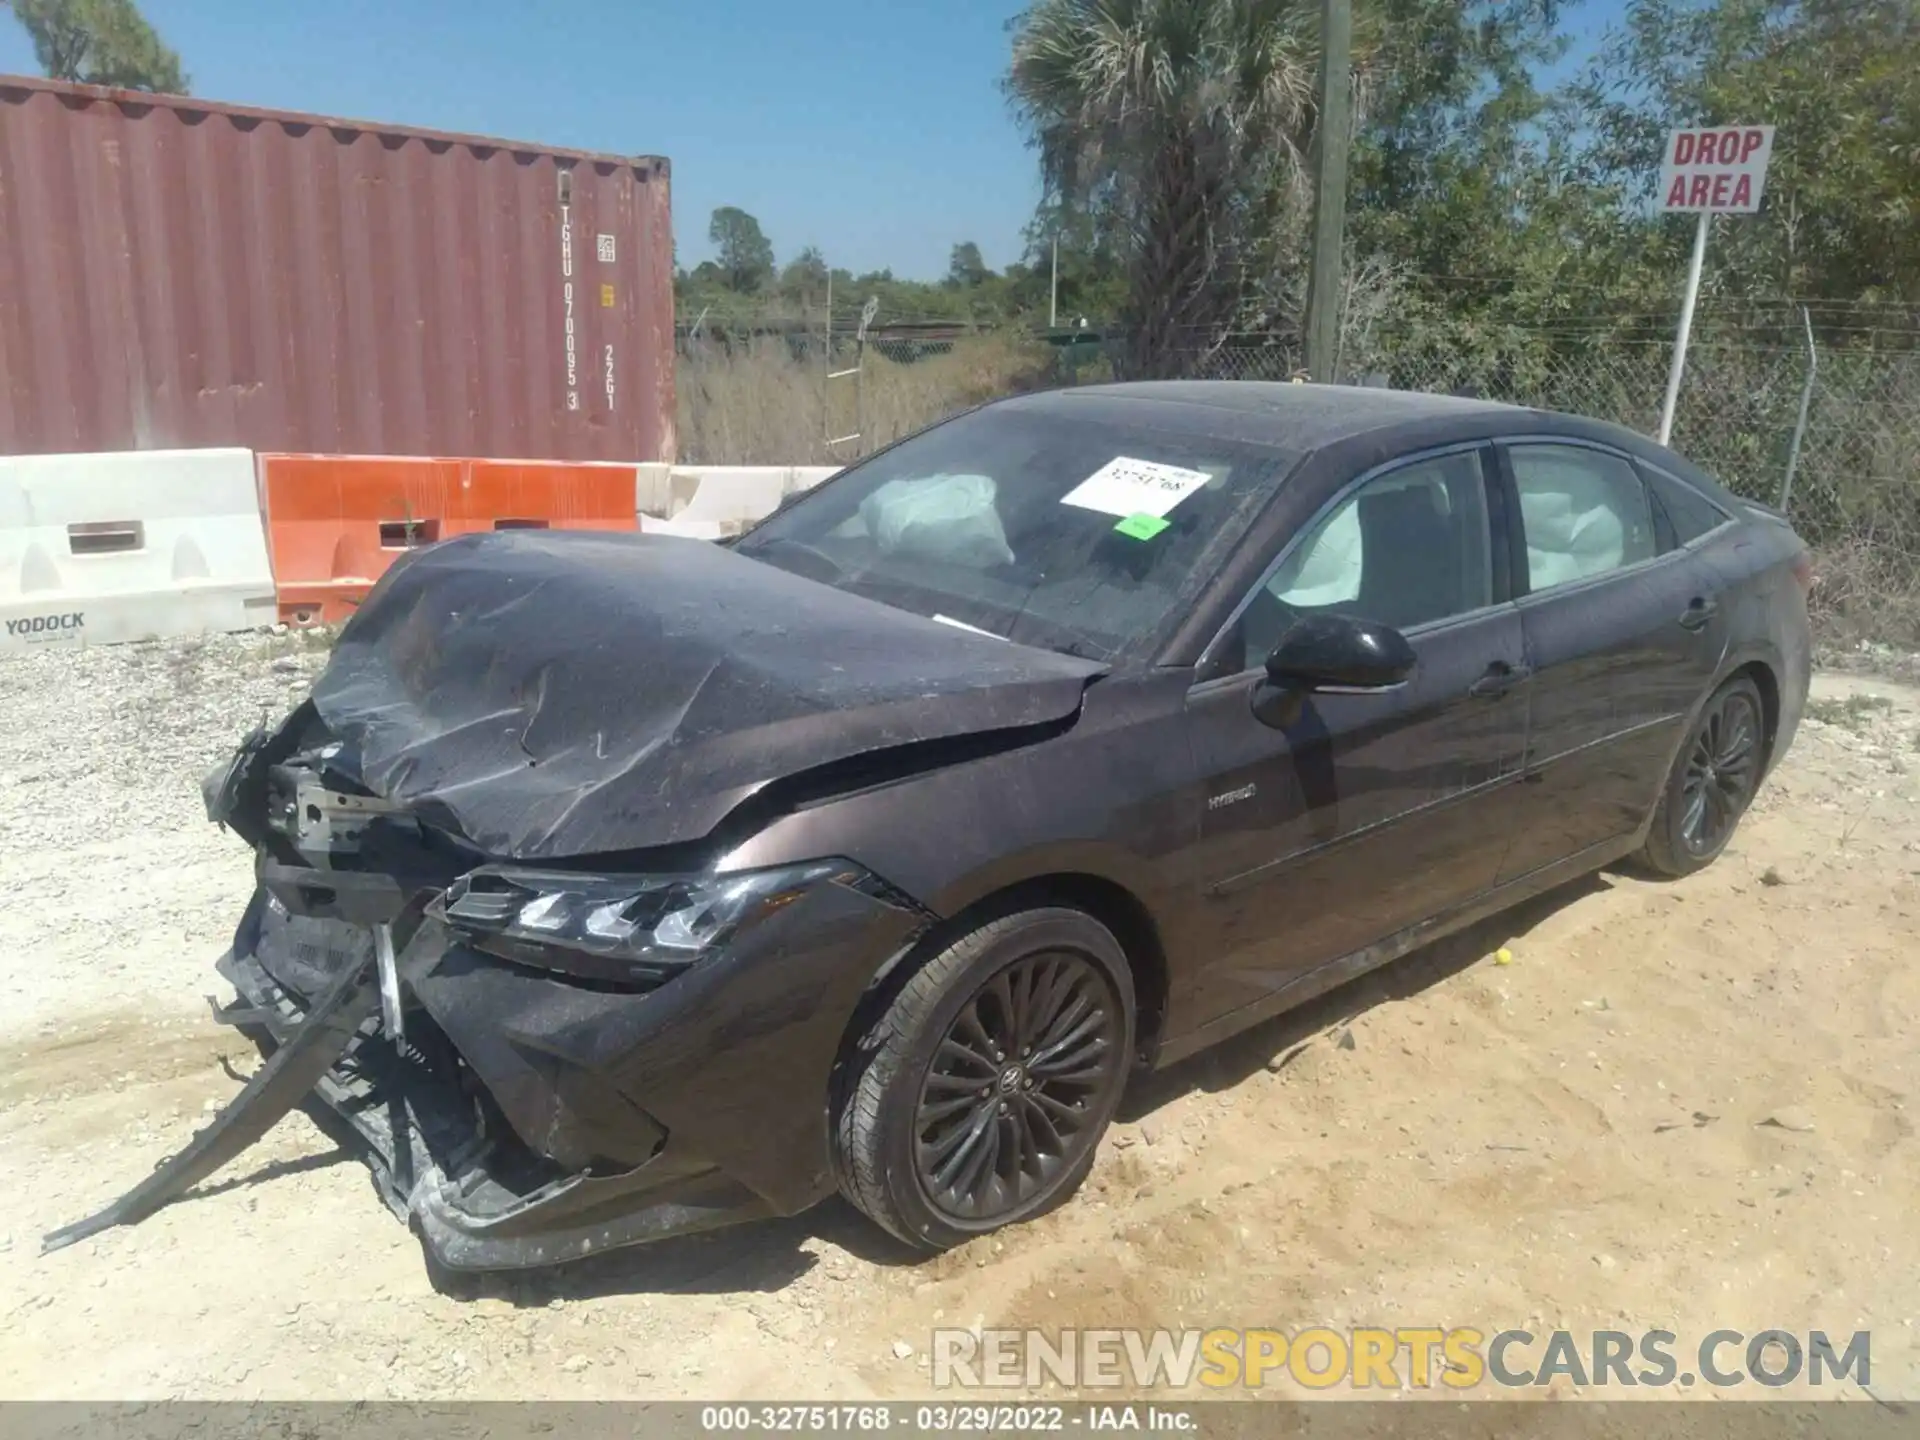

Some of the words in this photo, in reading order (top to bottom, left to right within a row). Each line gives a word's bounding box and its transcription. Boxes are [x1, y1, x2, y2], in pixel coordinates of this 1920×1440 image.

[1673, 130, 1763, 165] DROP
[1666, 173, 1751, 207] AREA
[561, 205, 573, 277] TGHU
[567, 391, 579, 411] 3
[605, 344, 614, 411] 22G1
[6, 612, 84, 636] YODOCK
[1208, 783, 1257, 811] HYBRID
